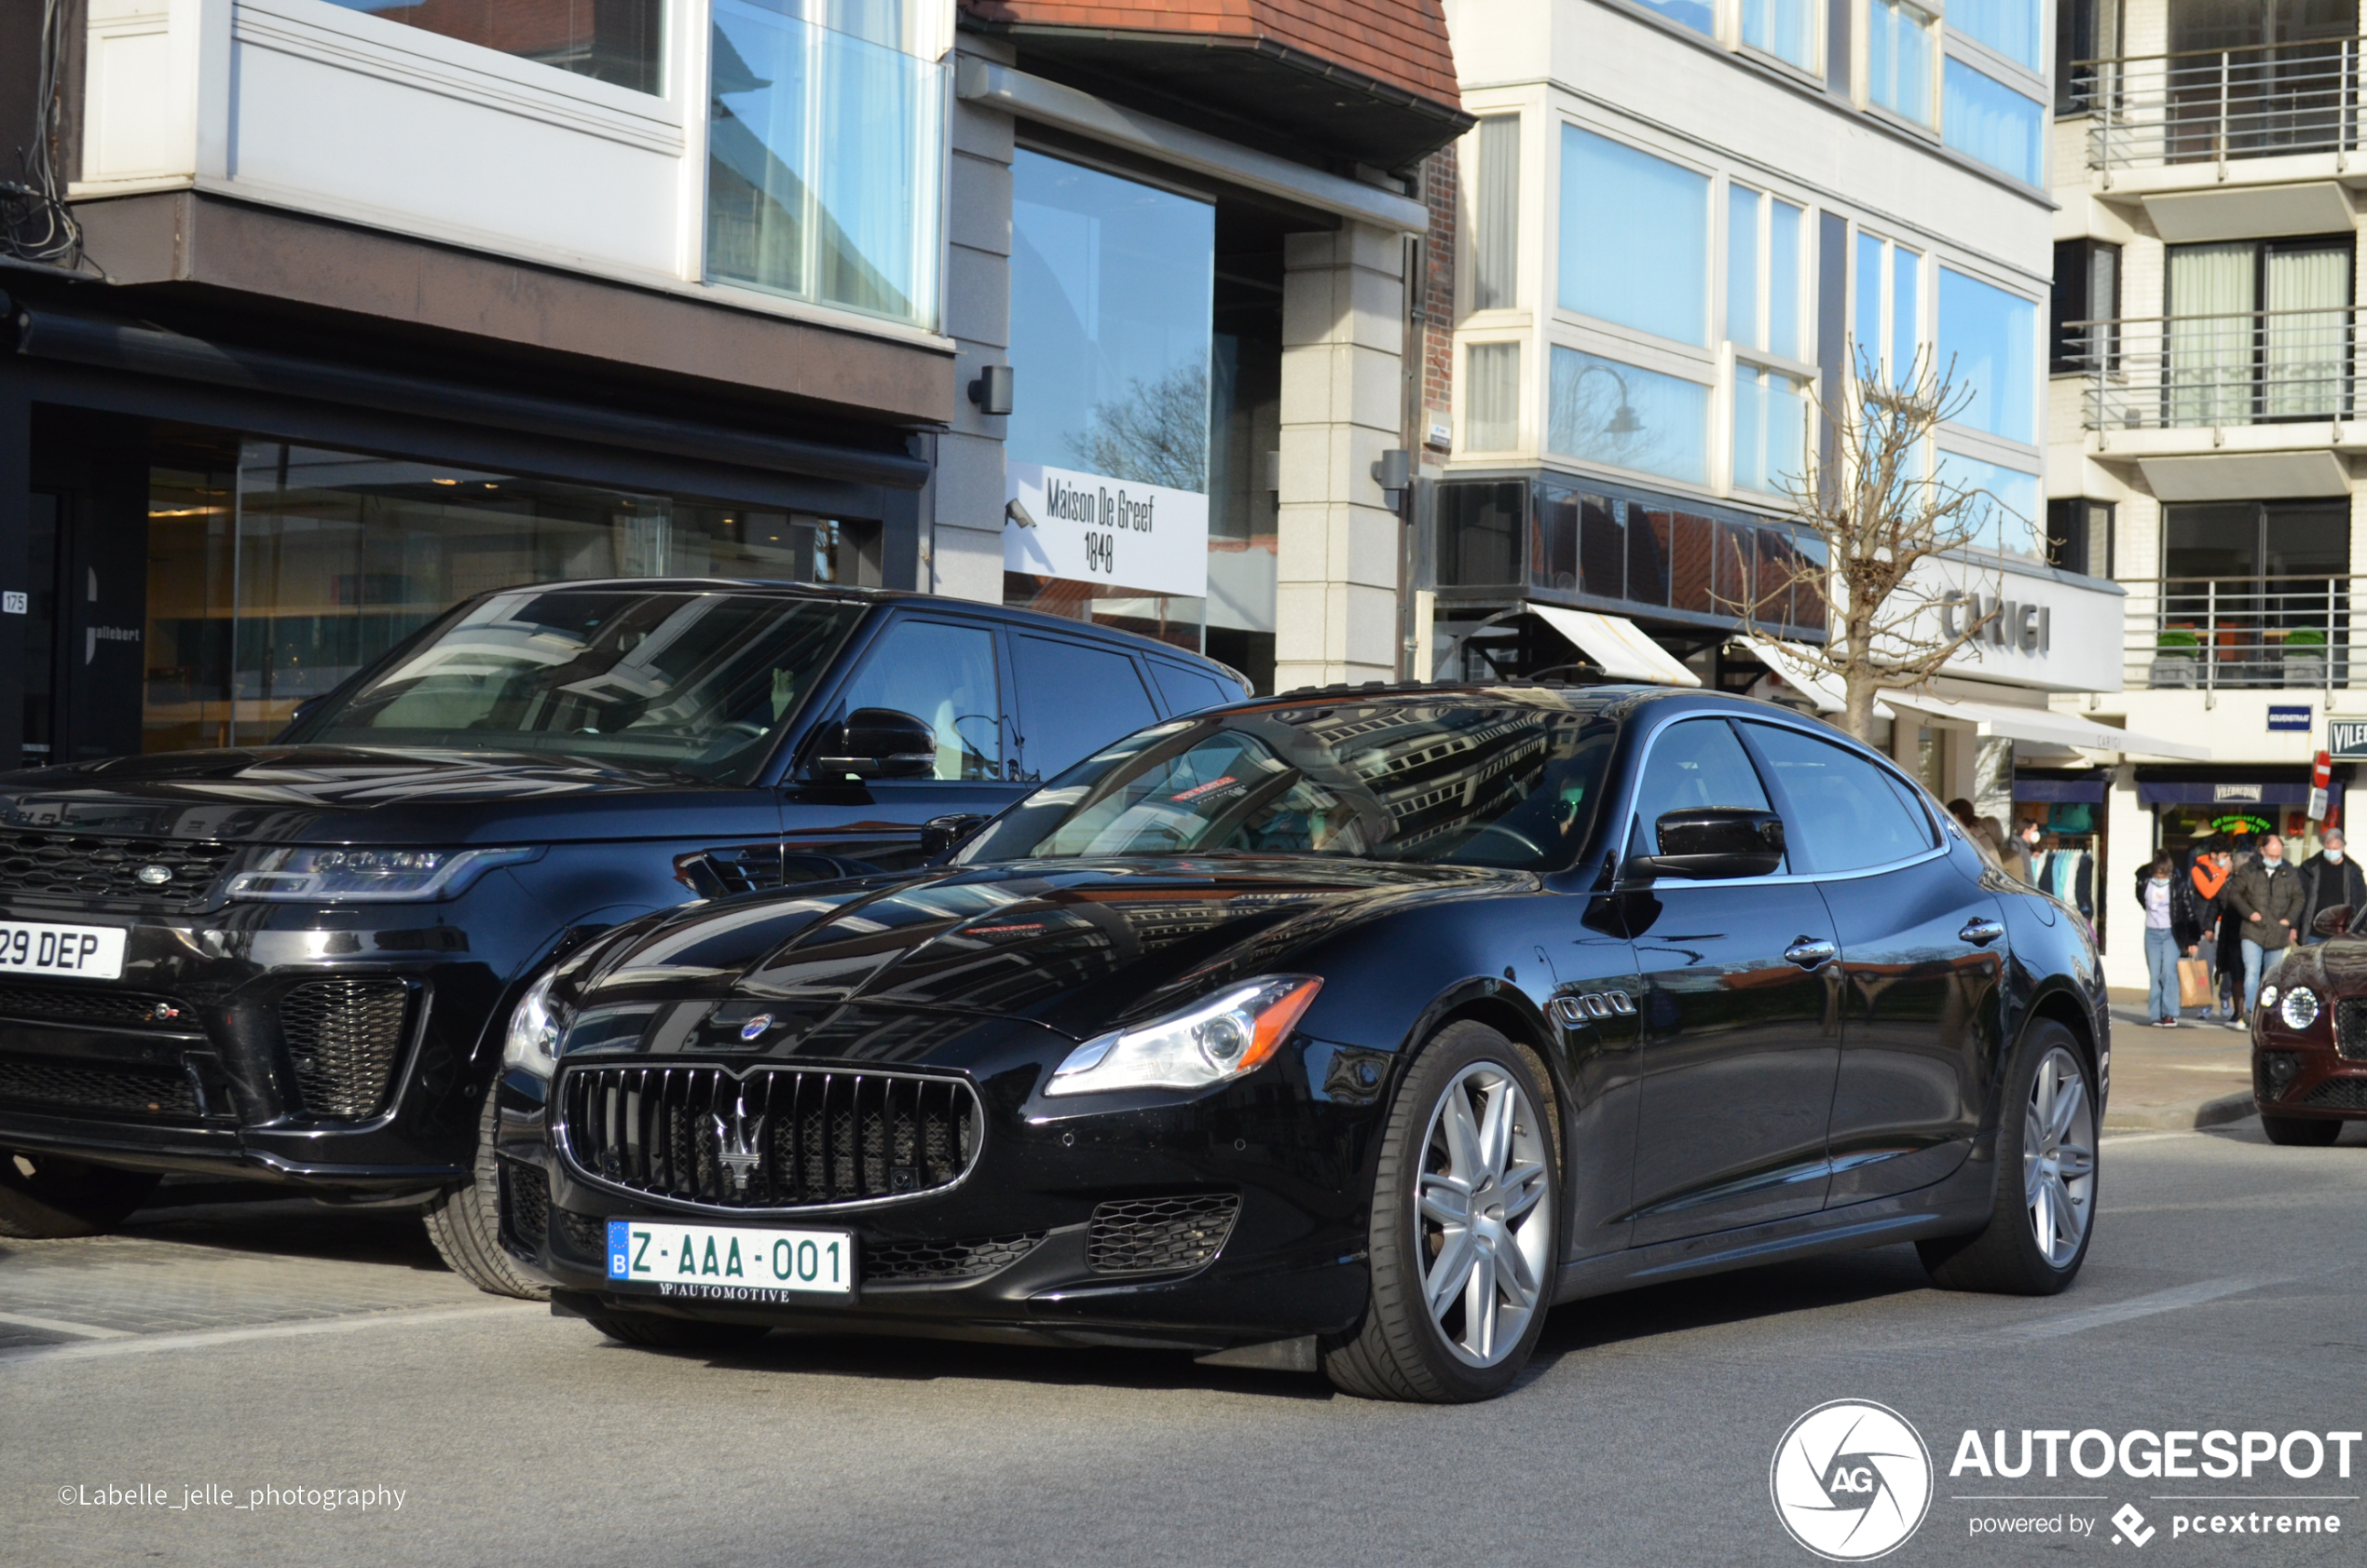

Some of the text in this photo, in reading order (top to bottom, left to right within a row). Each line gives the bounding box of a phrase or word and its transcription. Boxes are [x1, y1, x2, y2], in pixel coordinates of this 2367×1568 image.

[1047, 477, 1155, 533] Maison De Greef
[1085, 531, 1113, 574] 1848
[6, 594, 24, 611] 175
[1941, 590, 2050, 651] CARIGI
[36, 931, 99, 970] DEP
[613, 1254, 626, 1274] B
